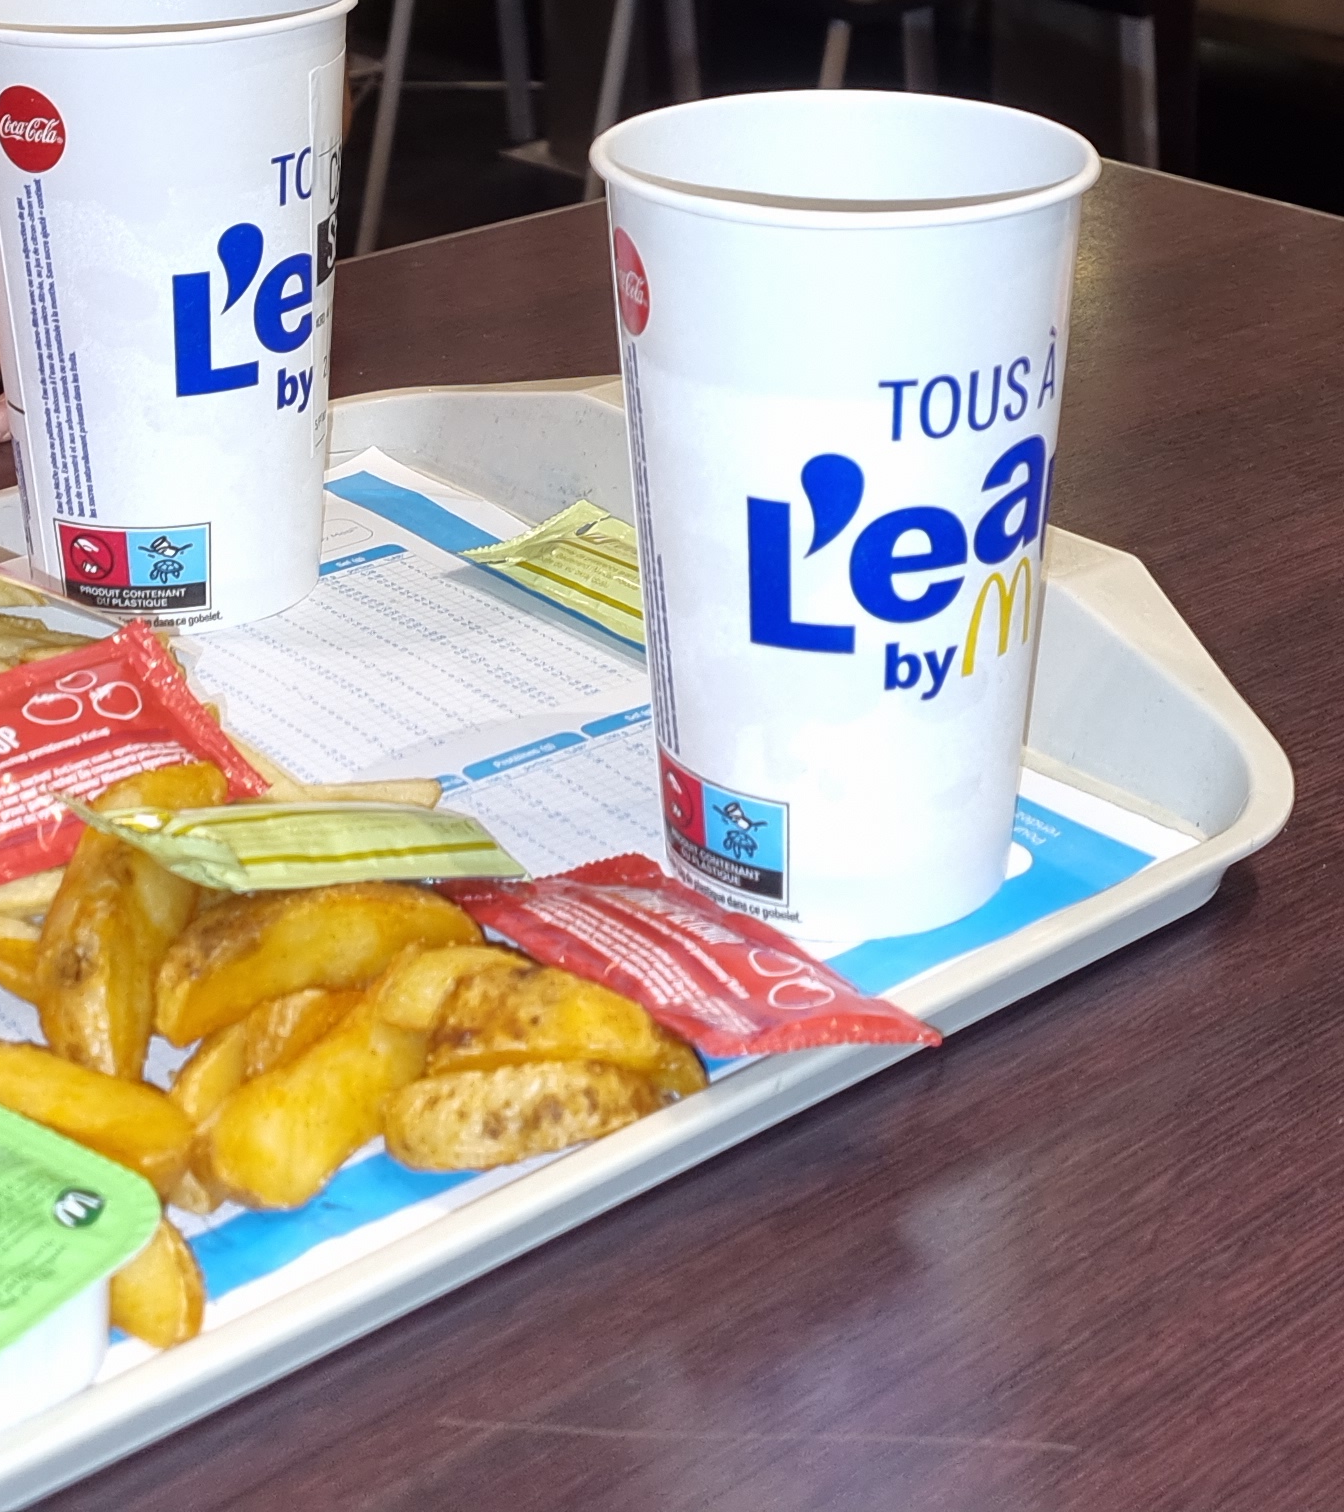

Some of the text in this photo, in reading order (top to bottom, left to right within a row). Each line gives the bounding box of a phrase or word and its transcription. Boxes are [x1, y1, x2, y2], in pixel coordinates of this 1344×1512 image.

[277, 366, 313, 413] by
[878, 356, 1031, 441] TOUS
[747, 434, 1056, 654] L'ea
[80, 585, 186, 598] PRODUIT CONTENANT
[97, 597, 168, 608] DU PLASTIQUE
[884, 641, 957, 700] by
